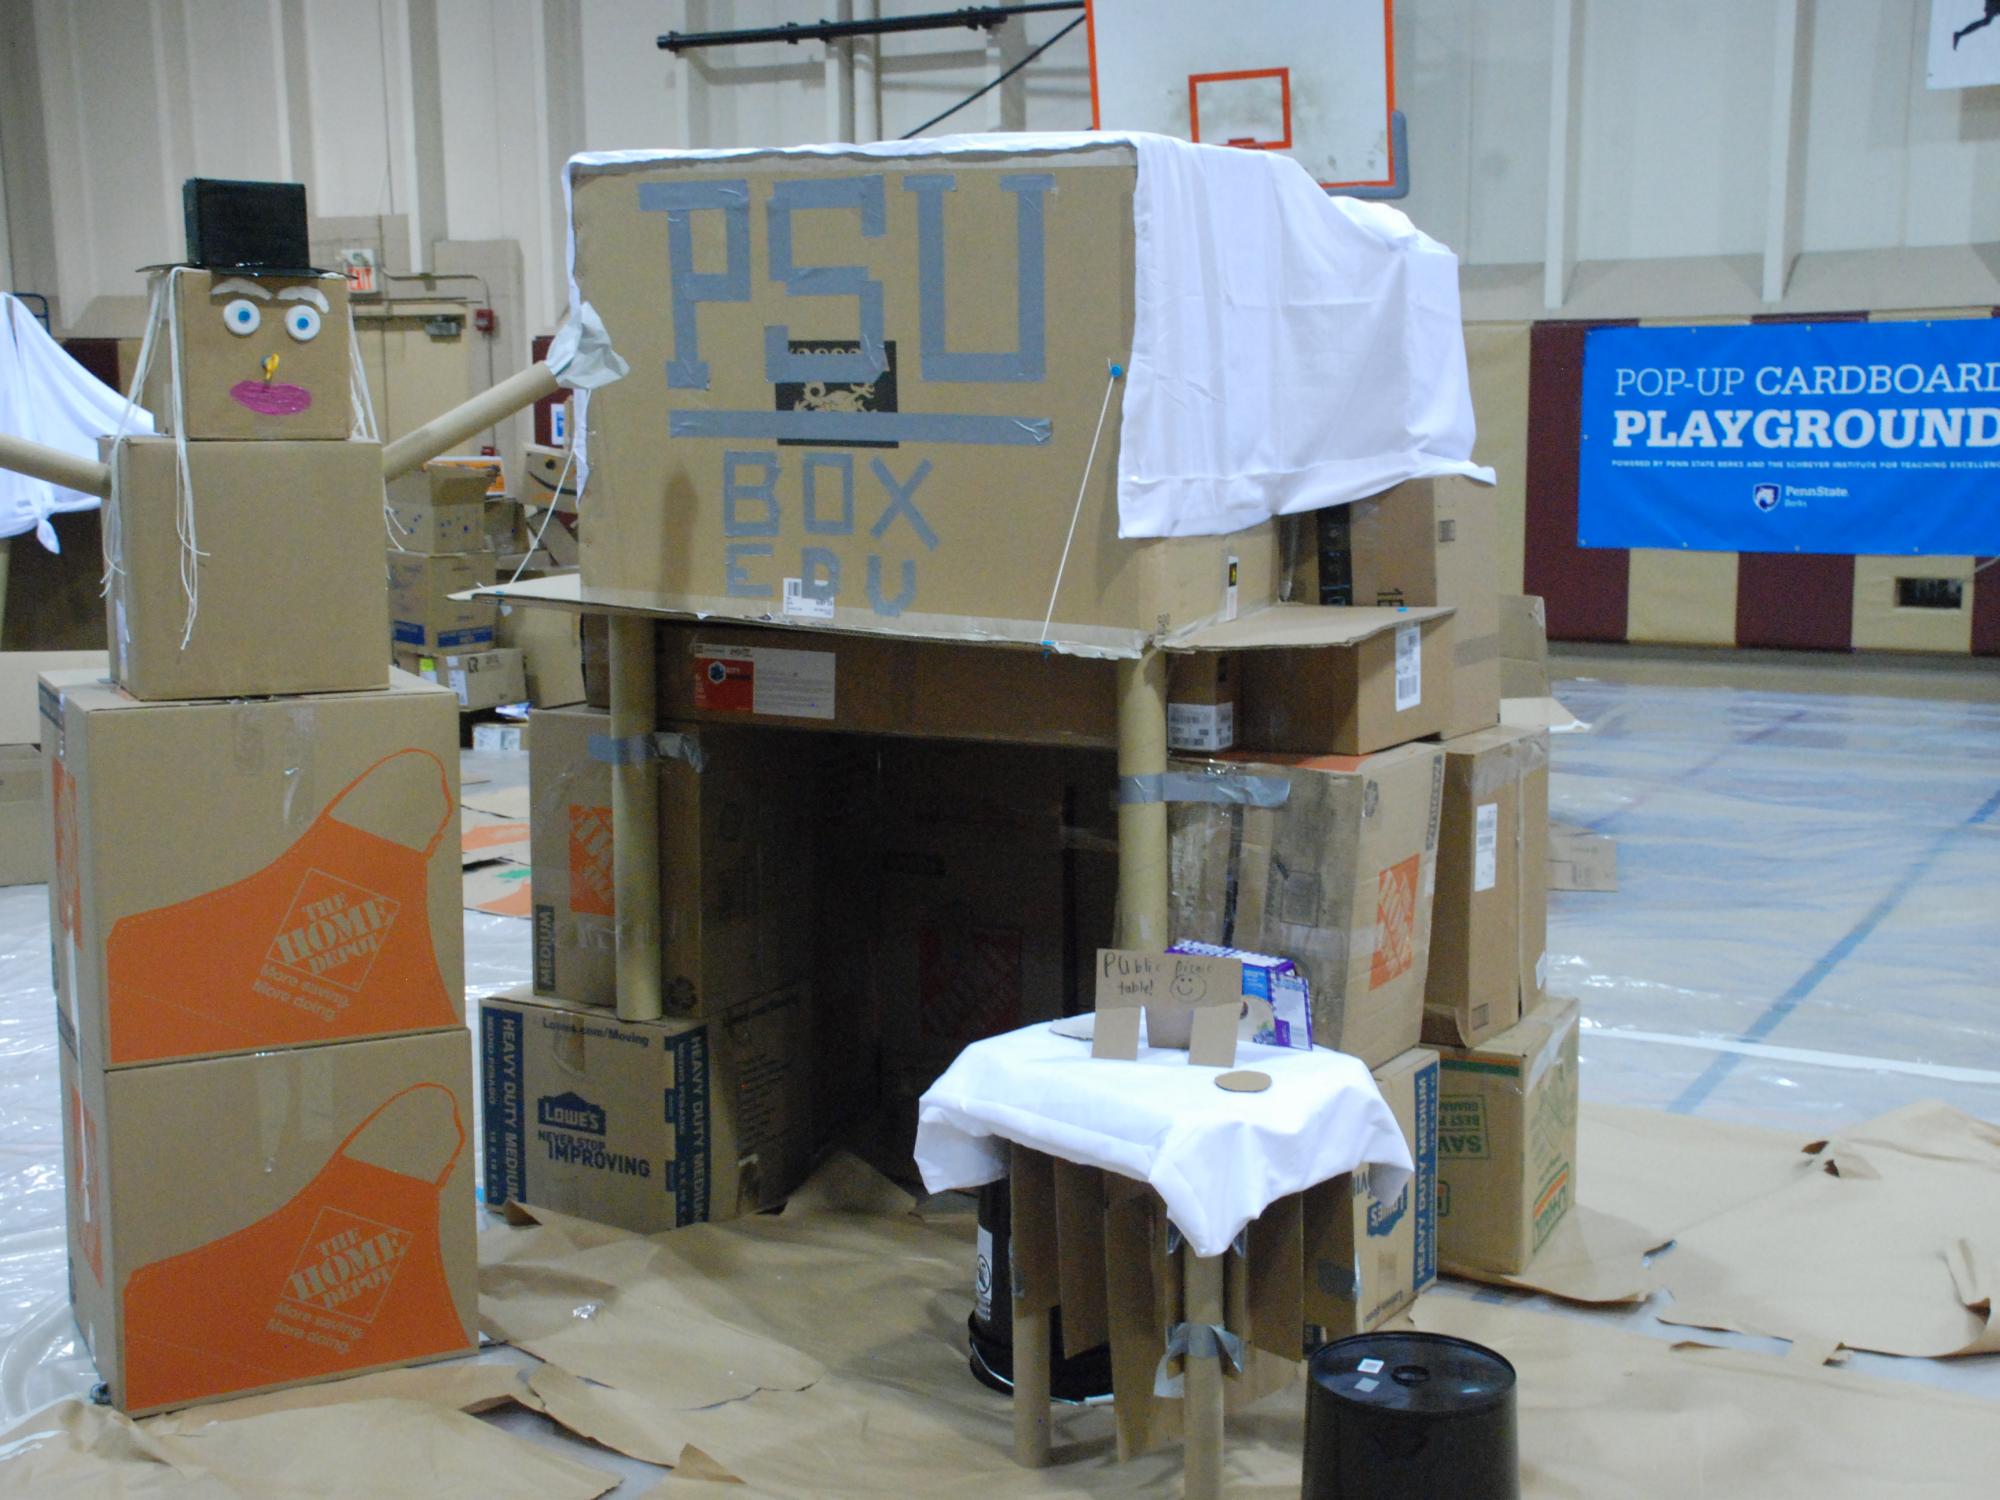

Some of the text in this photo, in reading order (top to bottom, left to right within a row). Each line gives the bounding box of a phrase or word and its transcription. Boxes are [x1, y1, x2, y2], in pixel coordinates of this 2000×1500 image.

[638, 173, 1056, 390] PSU
[1615, 362, 2000, 397] POP-UP CARDBOARD
[1612, 407, 2000, 449] PLAYGROUND
[1666, 460, 1689, 468] PENN
[1691, 460, 1715, 468] STATE
[1833, 461, 1876, 469] INSTITUTE
[1880, 461, 1897, 469] FOR
[1900, 461, 1946, 469] TEACHING
[723, 449, 940, 551] BOX
[1785, 486, 1848, 497] PennState
[725, 542, 917, 617] EDU
[302, 893, 347, 921] THE
[277, 900, 390, 966] HOME
[539, 911, 554, 987] MEDIUM
[310, 934, 380, 976] DEPOT
[253, 979, 291, 1002] More
[260, 963, 299, 987] More
[1118, 979, 1153, 996] table!
[691, 1036, 704, 1096] HEAVY
[503, 1018, 519, 1200] HEAVY DUTY MEDIUM
[545, 1102, 599, 1130] LOWE'S
[693, 1101, 705, 1146] DUTY
[538, 1131, 605, 1150] NEVER STOP
[548, 1144, 650, 1178] IMPROVING
[1416, 1076, 1428, 1280] HEAVY DUTY MEDIUM
[315, 1228, 359, 1256] THE
[292, 1233, 405, 1301] HOME
[322, 1266, 391, 1312] DEPOT
[266, 1318, 304, 1340] More
[274, 1302, 312, 1322] More
